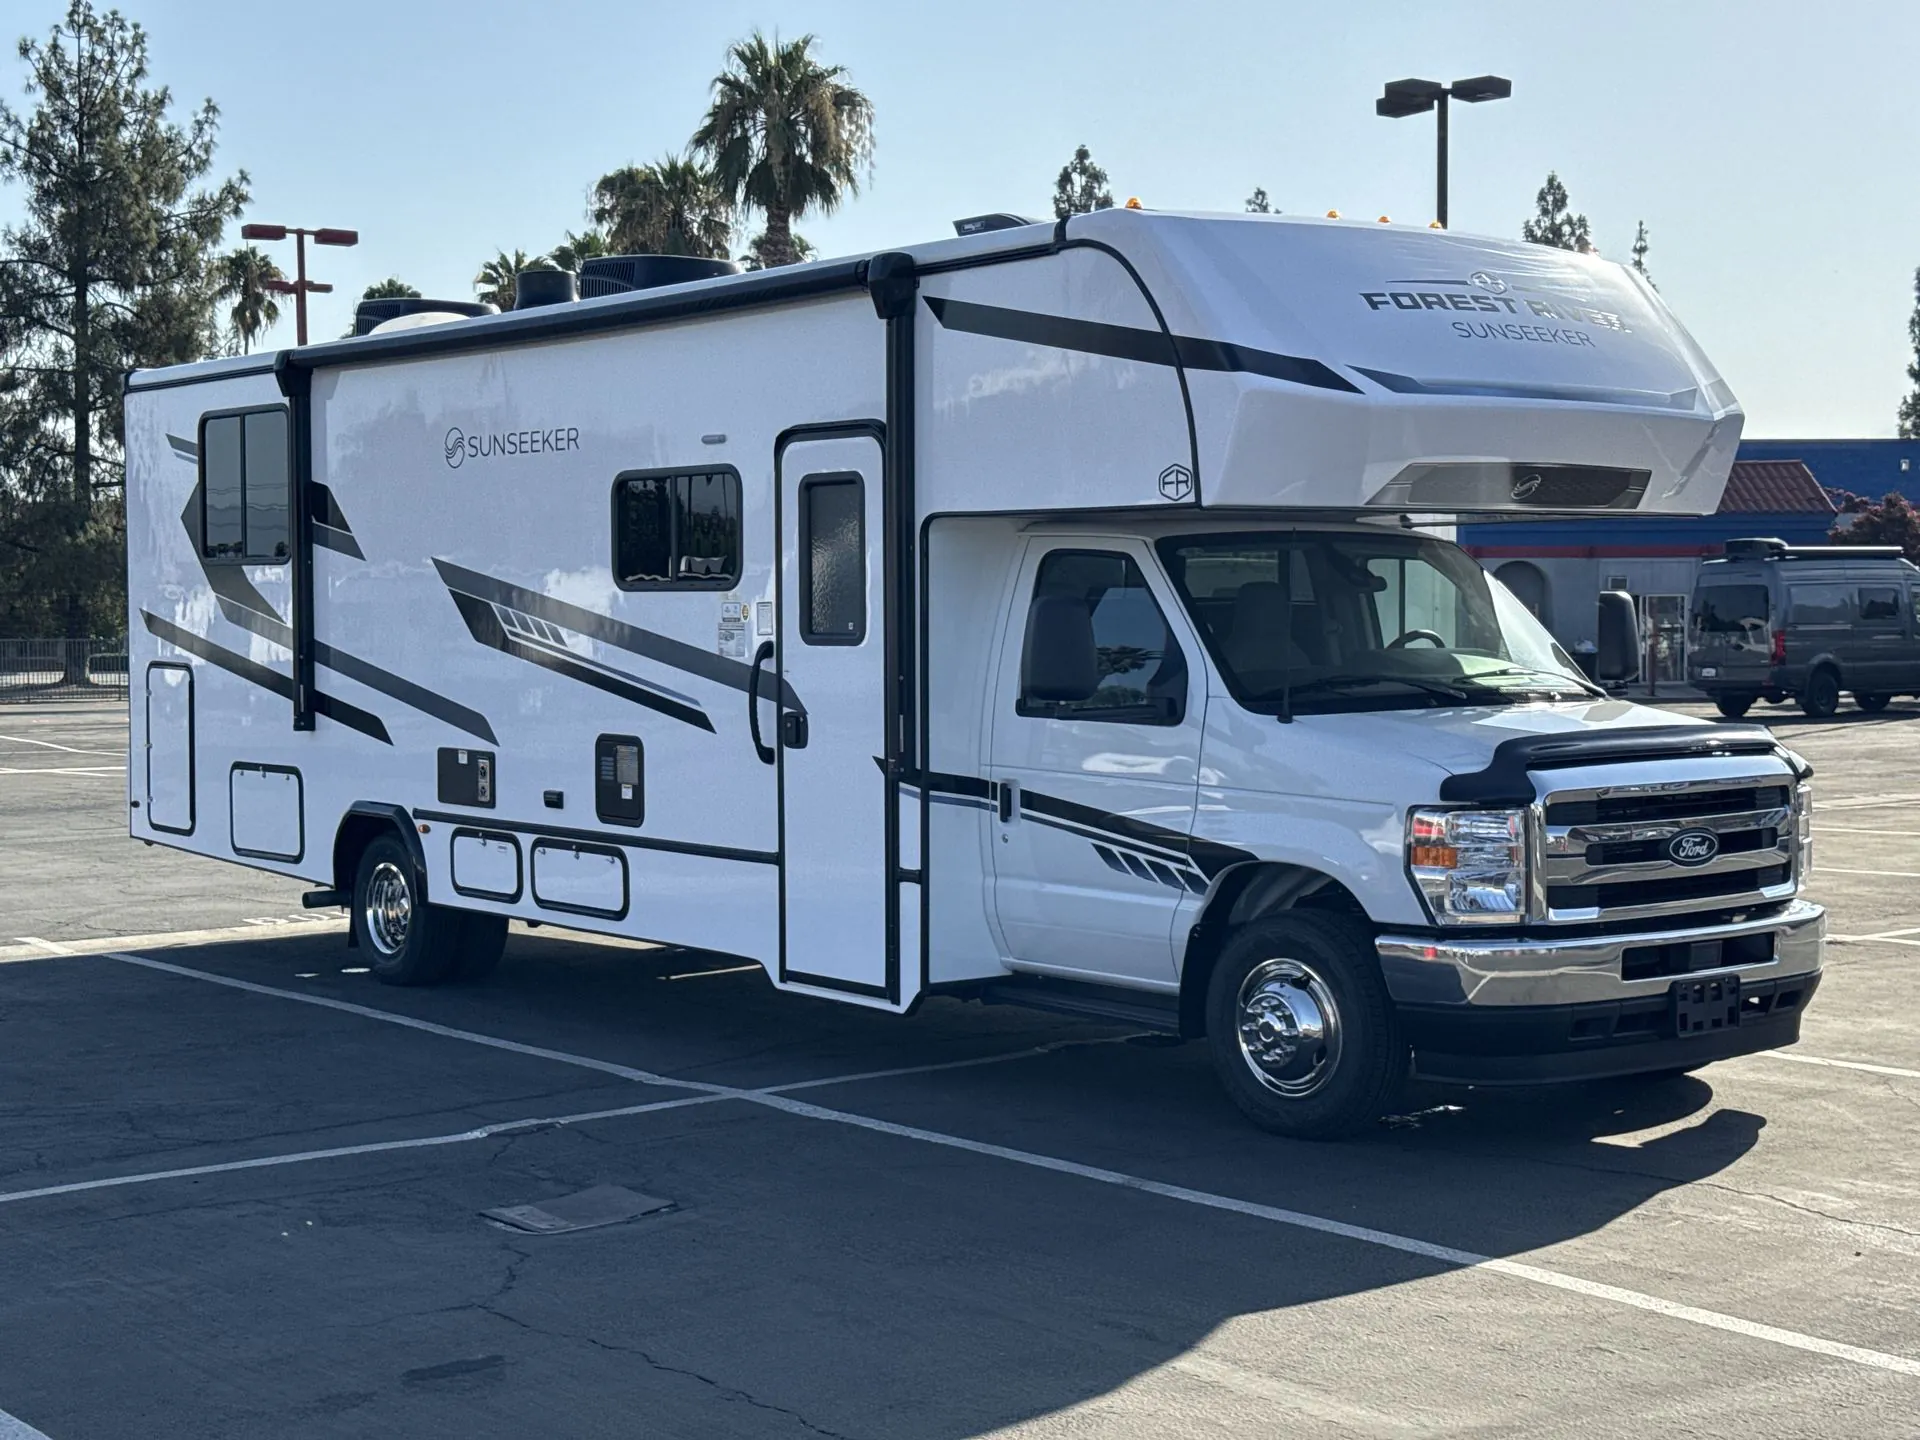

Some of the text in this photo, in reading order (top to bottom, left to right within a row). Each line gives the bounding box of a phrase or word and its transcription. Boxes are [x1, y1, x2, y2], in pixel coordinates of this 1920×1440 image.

[1359, 292, 1518, 314] FOREST
[1451, 321, 1596, 348] SUNSEEKER
[468, 427, 580, 458] SUNSEEKER
[1679, 837, 1710, 857] Ford
